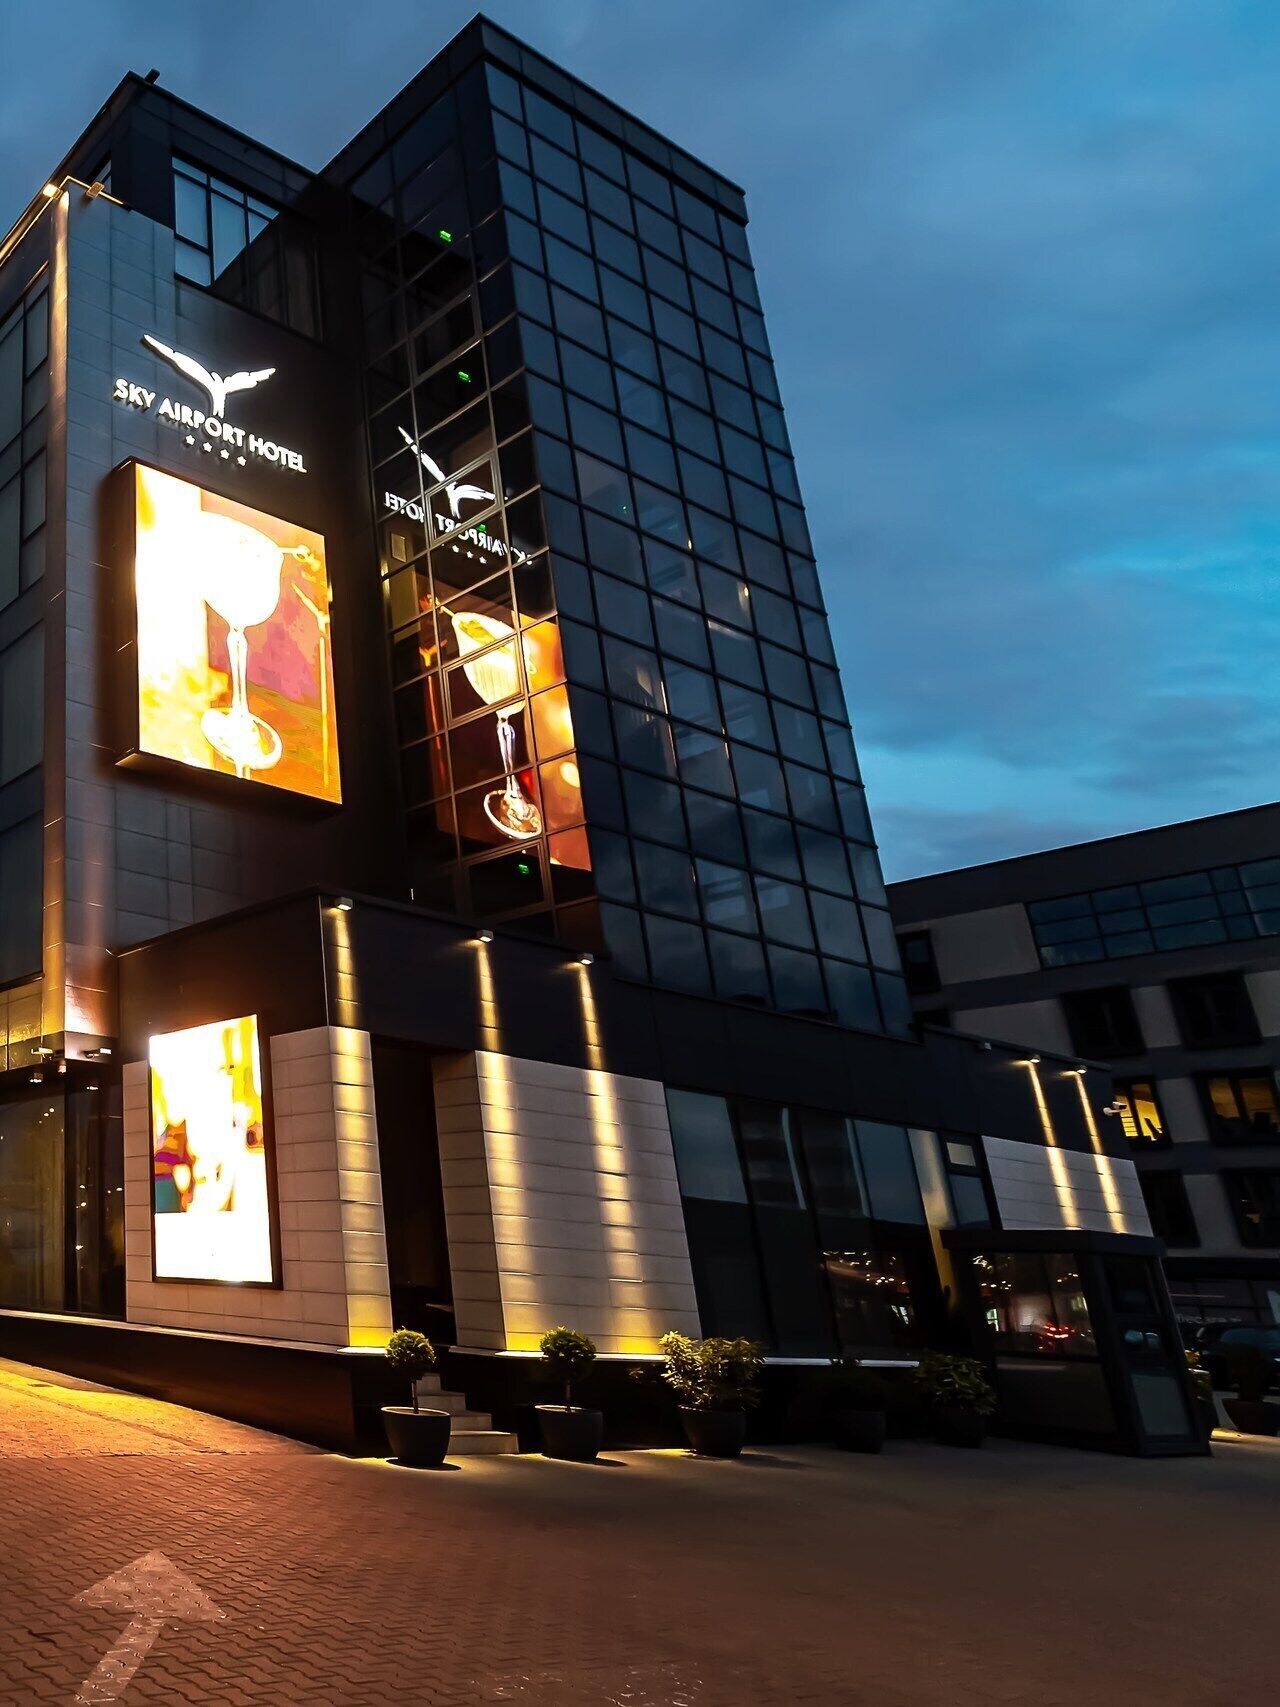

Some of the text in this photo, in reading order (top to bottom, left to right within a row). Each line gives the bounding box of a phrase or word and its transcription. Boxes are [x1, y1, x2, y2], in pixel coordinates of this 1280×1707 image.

[113, 378, 308, 474] SKY AIRPORT HOTEL
